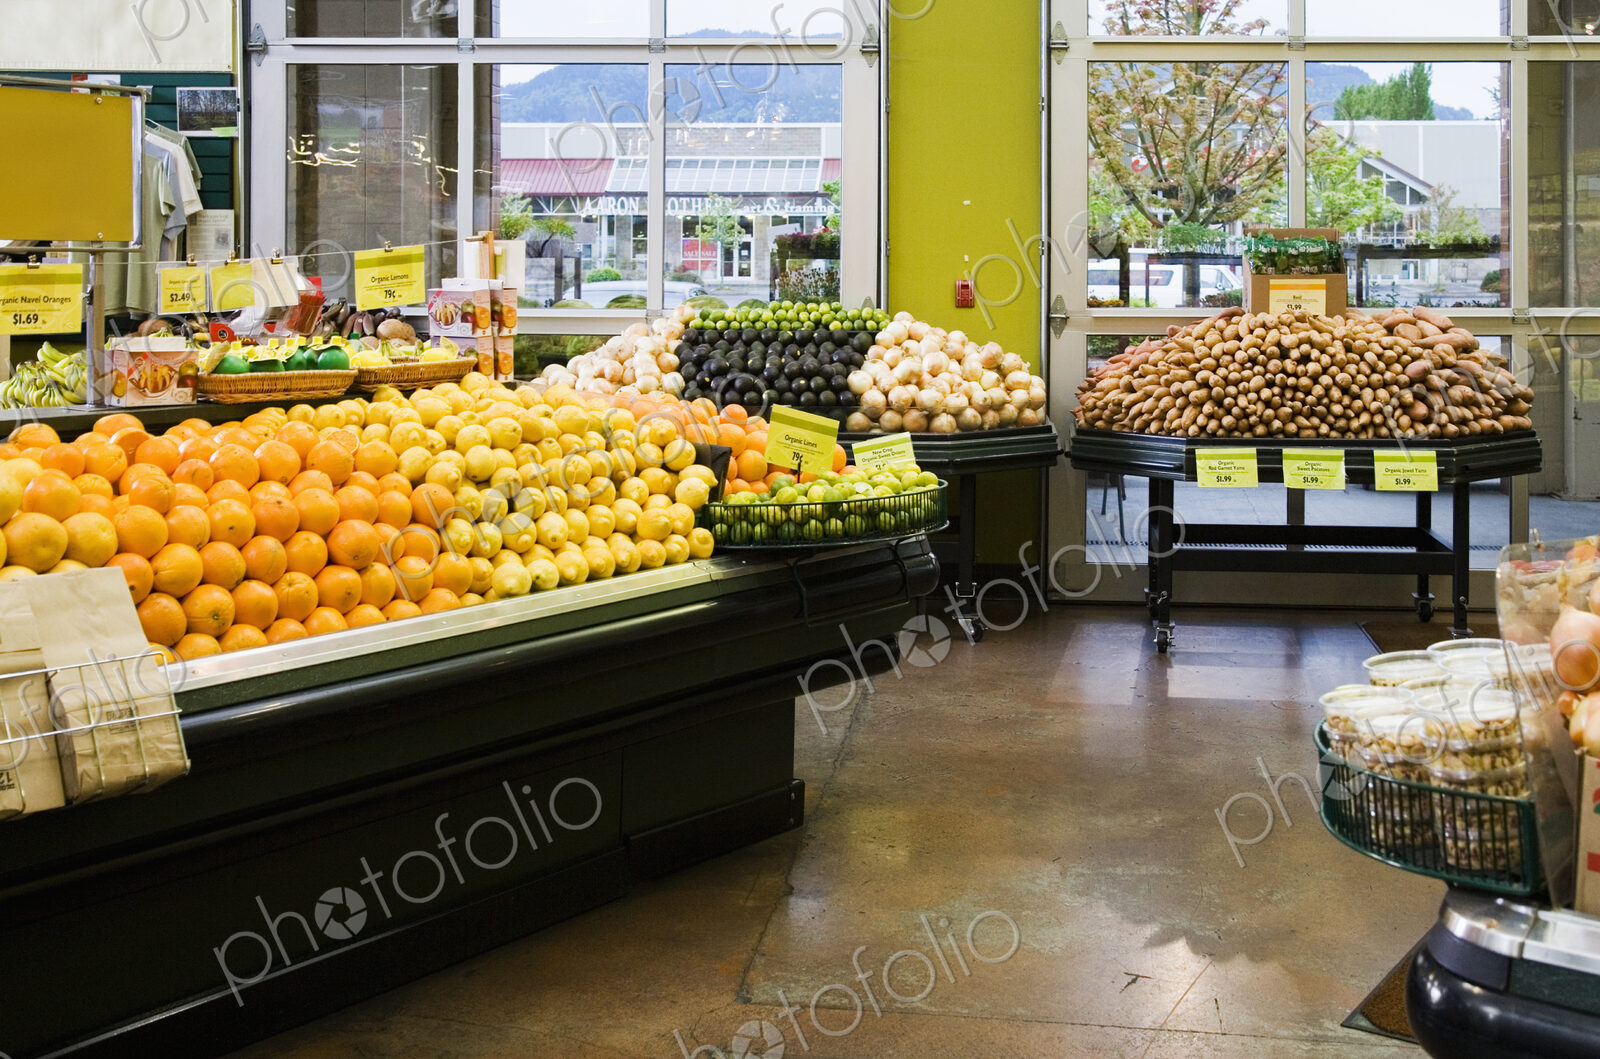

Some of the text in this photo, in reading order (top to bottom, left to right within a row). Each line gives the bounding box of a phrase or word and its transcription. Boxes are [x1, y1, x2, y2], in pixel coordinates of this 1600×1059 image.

[583, 196, 640, 216] AARON
[743, 203, 760, 213] art
[763, 197, 780, 215] &
[784, 201, 835, 215] framing
[370, 273, 409, 284] Organic Lemons
[169, 292, 191, 303] $2.49
[384, 289, 396, 299] 79¢
[0, 295, 72, 306] rganic Navel Oranges
[13, 313, 39, 325] $1.69
[784, 434, 803, 445] Organic
[803, 439, 817, 448] Limes
[1216, 475, 1232, 483] $1.99
[1302, 476, 1319, 484] $1.99
[1395, 477, 1411, 485] $1.99
